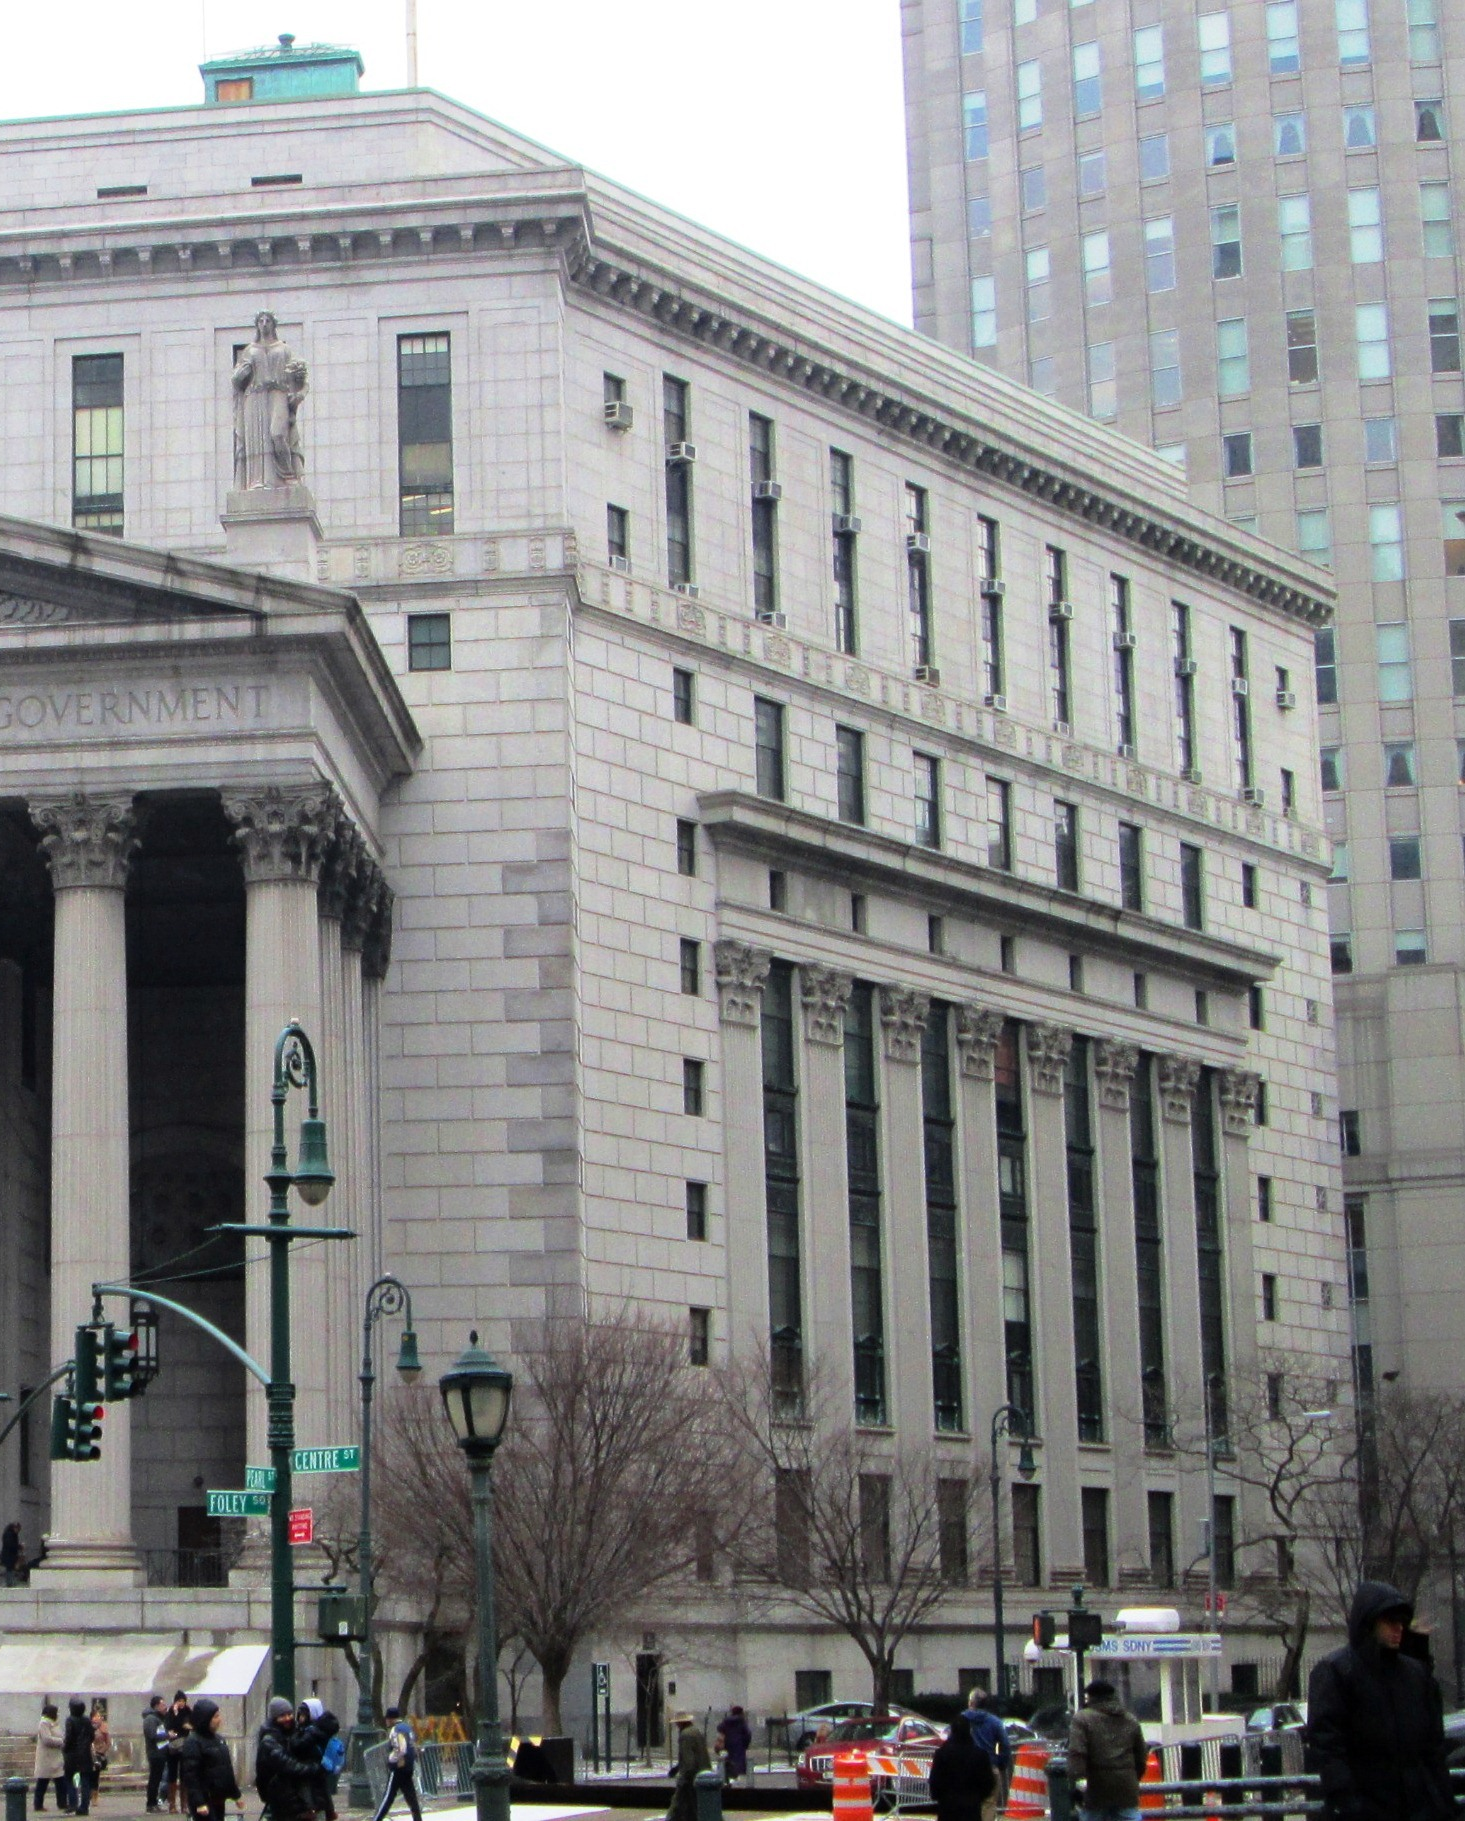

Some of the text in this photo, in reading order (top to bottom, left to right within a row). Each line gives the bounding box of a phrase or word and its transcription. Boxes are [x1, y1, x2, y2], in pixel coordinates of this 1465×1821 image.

[295, 1449, 355, 1470] CENTRE ST
[247, 1469, 266, 1489] PEARL
[210, 1495, 247, 1513] FOLEY
[1123, 1639, 1153, 1652] SDNY
